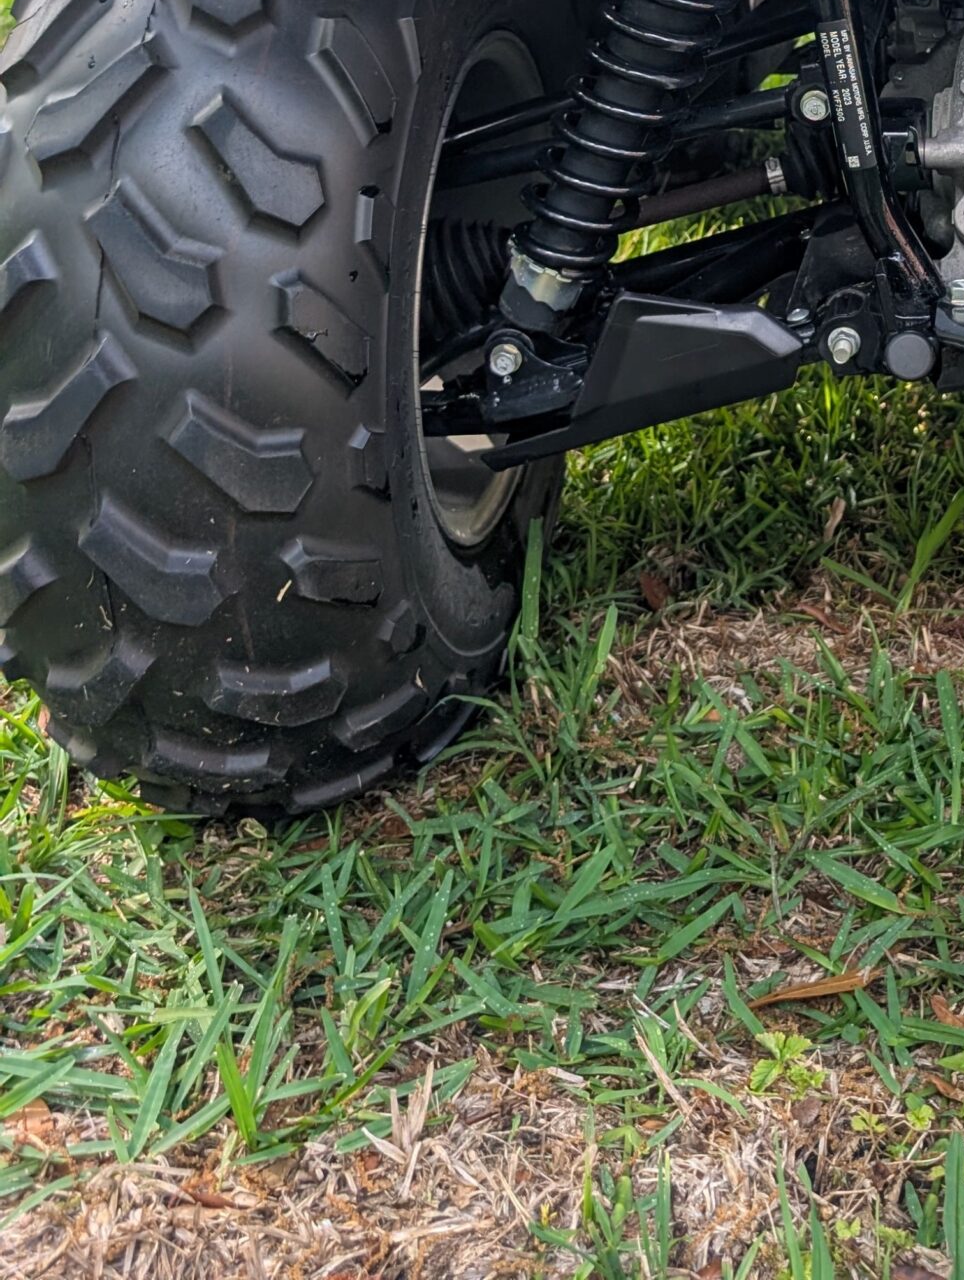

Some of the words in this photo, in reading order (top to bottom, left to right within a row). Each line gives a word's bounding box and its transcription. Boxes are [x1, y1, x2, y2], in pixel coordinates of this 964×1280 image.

[820, 32, 831, 59] MODEL
[832, 89, 845, 122] KVF750G
[830, 31, 842, 58] MODEL
[841, 88, 852, 106] 2023
[851, 82, 863, 106] MOTORS
